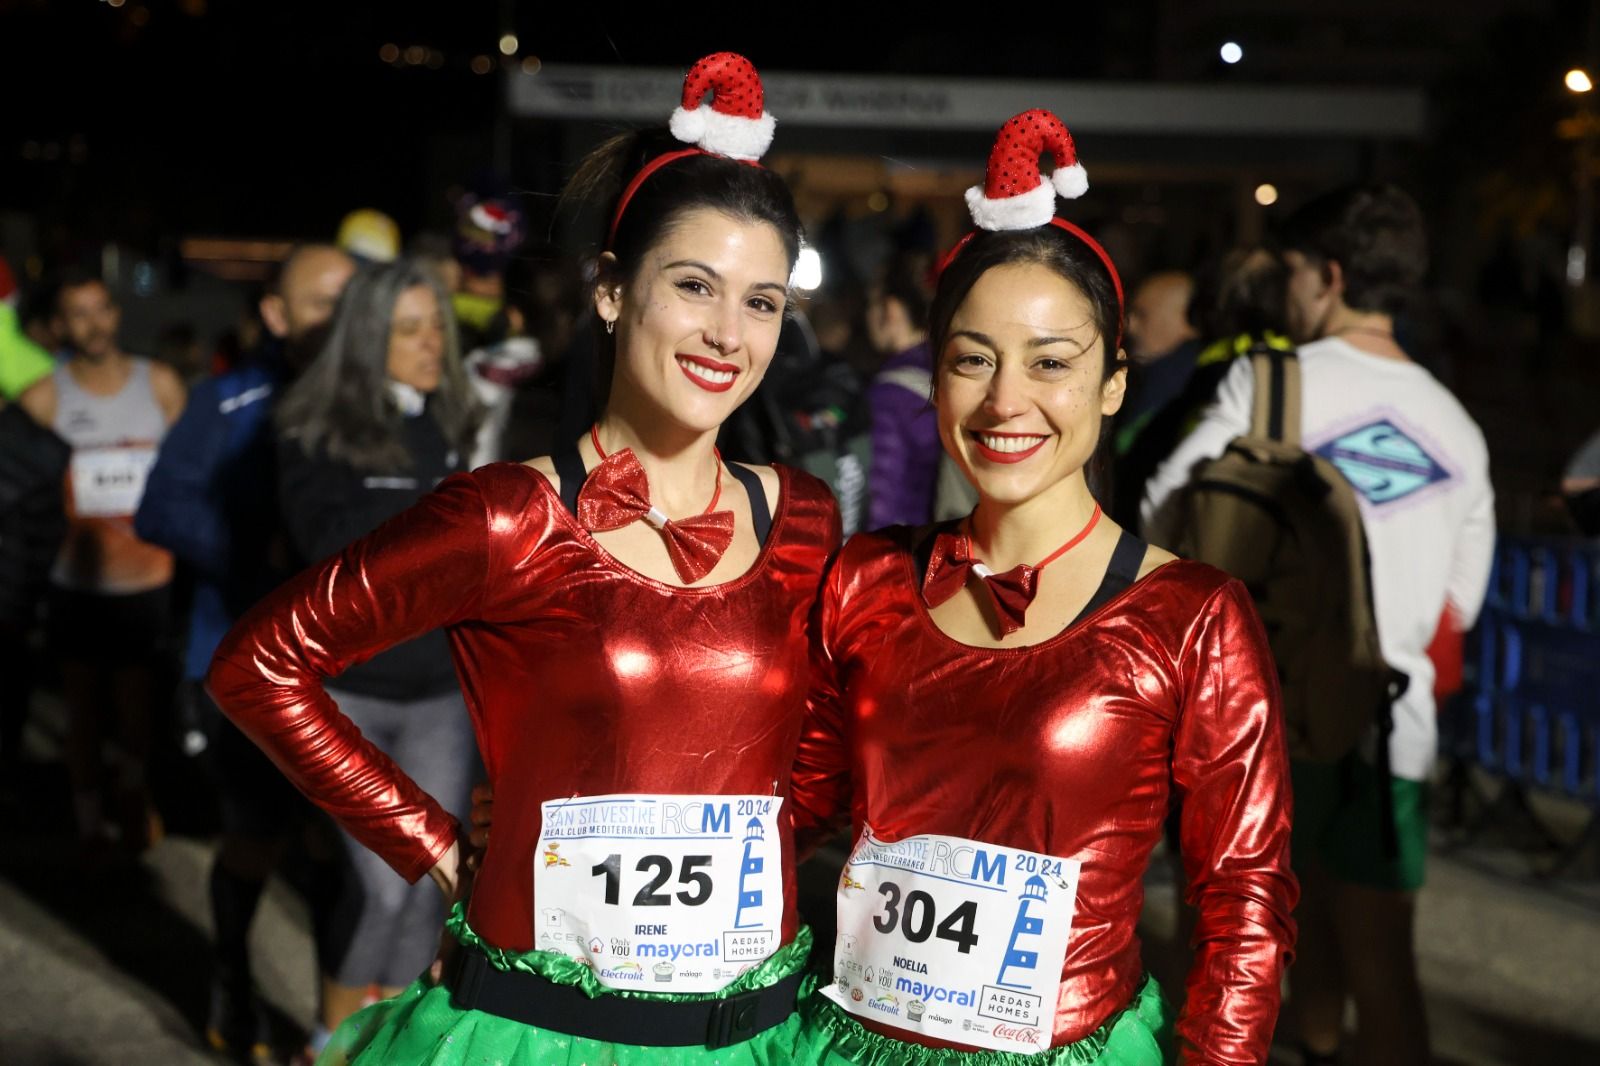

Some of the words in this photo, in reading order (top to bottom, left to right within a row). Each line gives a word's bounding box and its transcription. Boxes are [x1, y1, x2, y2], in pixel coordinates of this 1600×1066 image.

[737, 799, 771, 816] 2024
[545, 809, 574, 828] SAN
[579, 805, 657, 825] SILVESTRE
[661, 802, 730, 834] RCM
[544, 828, 565, 836] REAL
[567, 827, 587, 836] CLUB
[930, 841, 1007, 885] RCM
[1015, 854, 1062, 877] 2024
[592, 854, 713, 907] 125
[873, 881, 979, 954] 304
[540, 931, 585, 945] ACER
[634, 924, 668, 936] IRENE
[731, 937, 766, 945] AEDAS
[611, 945, 630, 957] YOU
[636, 939, 719, 961] mayoral
[731, 947, 765, 956] HOMES
[893, 956, 928, 975] NOELIA
[878, 975, 893, 988] YOU
[896, 976, 976, 1008] mayoral
[991, 994, 1032, 1008] AEDAS
[988, 1004, 1029, 1019] HOMES
